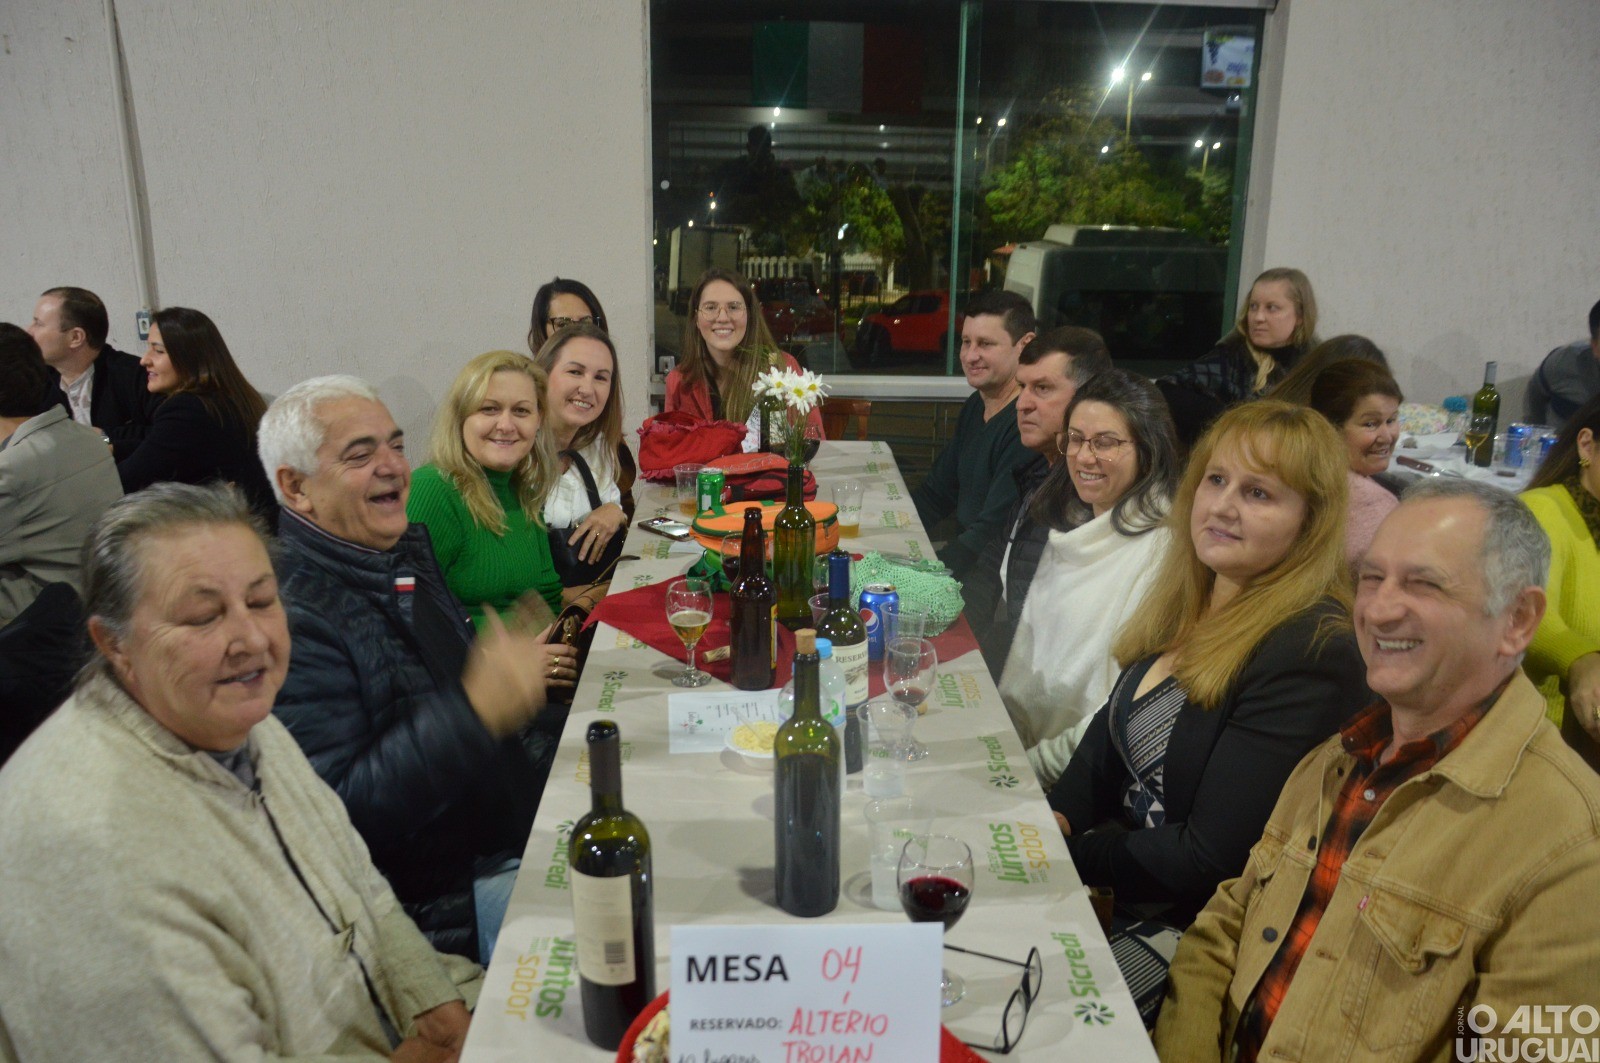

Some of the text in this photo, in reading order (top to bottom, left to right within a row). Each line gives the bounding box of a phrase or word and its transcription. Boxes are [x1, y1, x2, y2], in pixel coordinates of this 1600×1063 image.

[597, 680, 622, 713] Sicredi
[937, 673, 965, 708] Juntos
[977, 735, 1011, 772] Sicredi
[989, 822, 1030, 884] Juntos
[1017, 820, 1050, 870] sabor
[686, 946, 862, 983] MESA 04
[1050, 931, 1101, 998] Sicredi
[505, 953, 542, 1022] sabor
[690, 1016, 782, 1031] RESERVADO:
